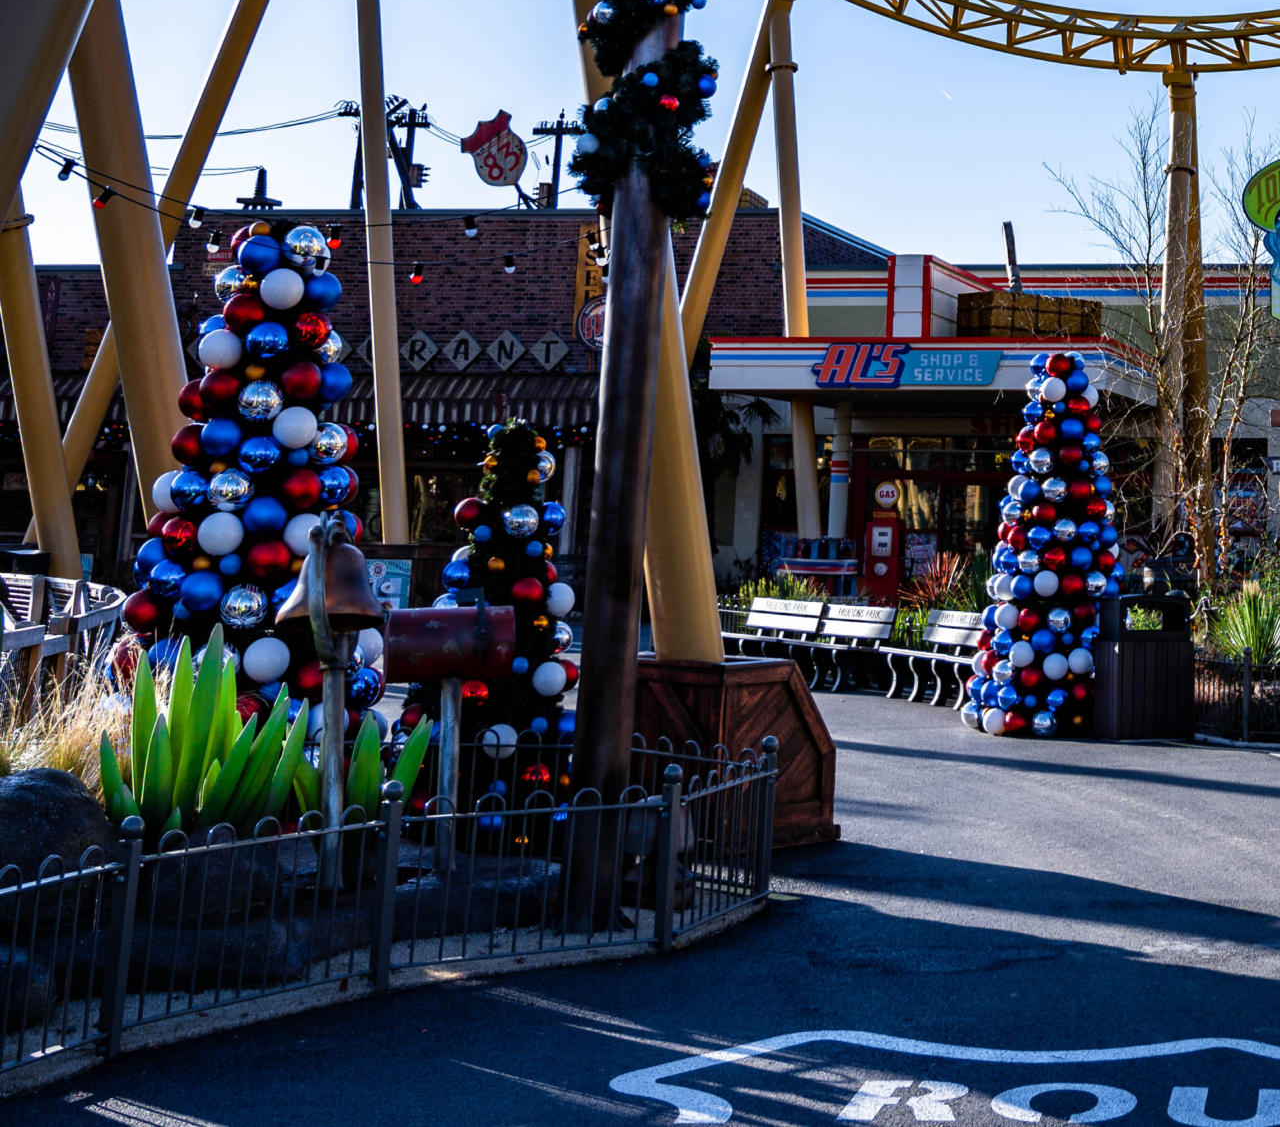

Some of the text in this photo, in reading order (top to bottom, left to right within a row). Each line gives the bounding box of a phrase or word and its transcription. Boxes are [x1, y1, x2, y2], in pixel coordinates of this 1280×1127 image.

[483, 141, 520, 180] 83
[813, 344, 906, 384] AL'S
[919, 354, 978, 366] SHOP &
[914, 368, 983, 382] SERVICE
[879, 490, 895, 499] GAS
